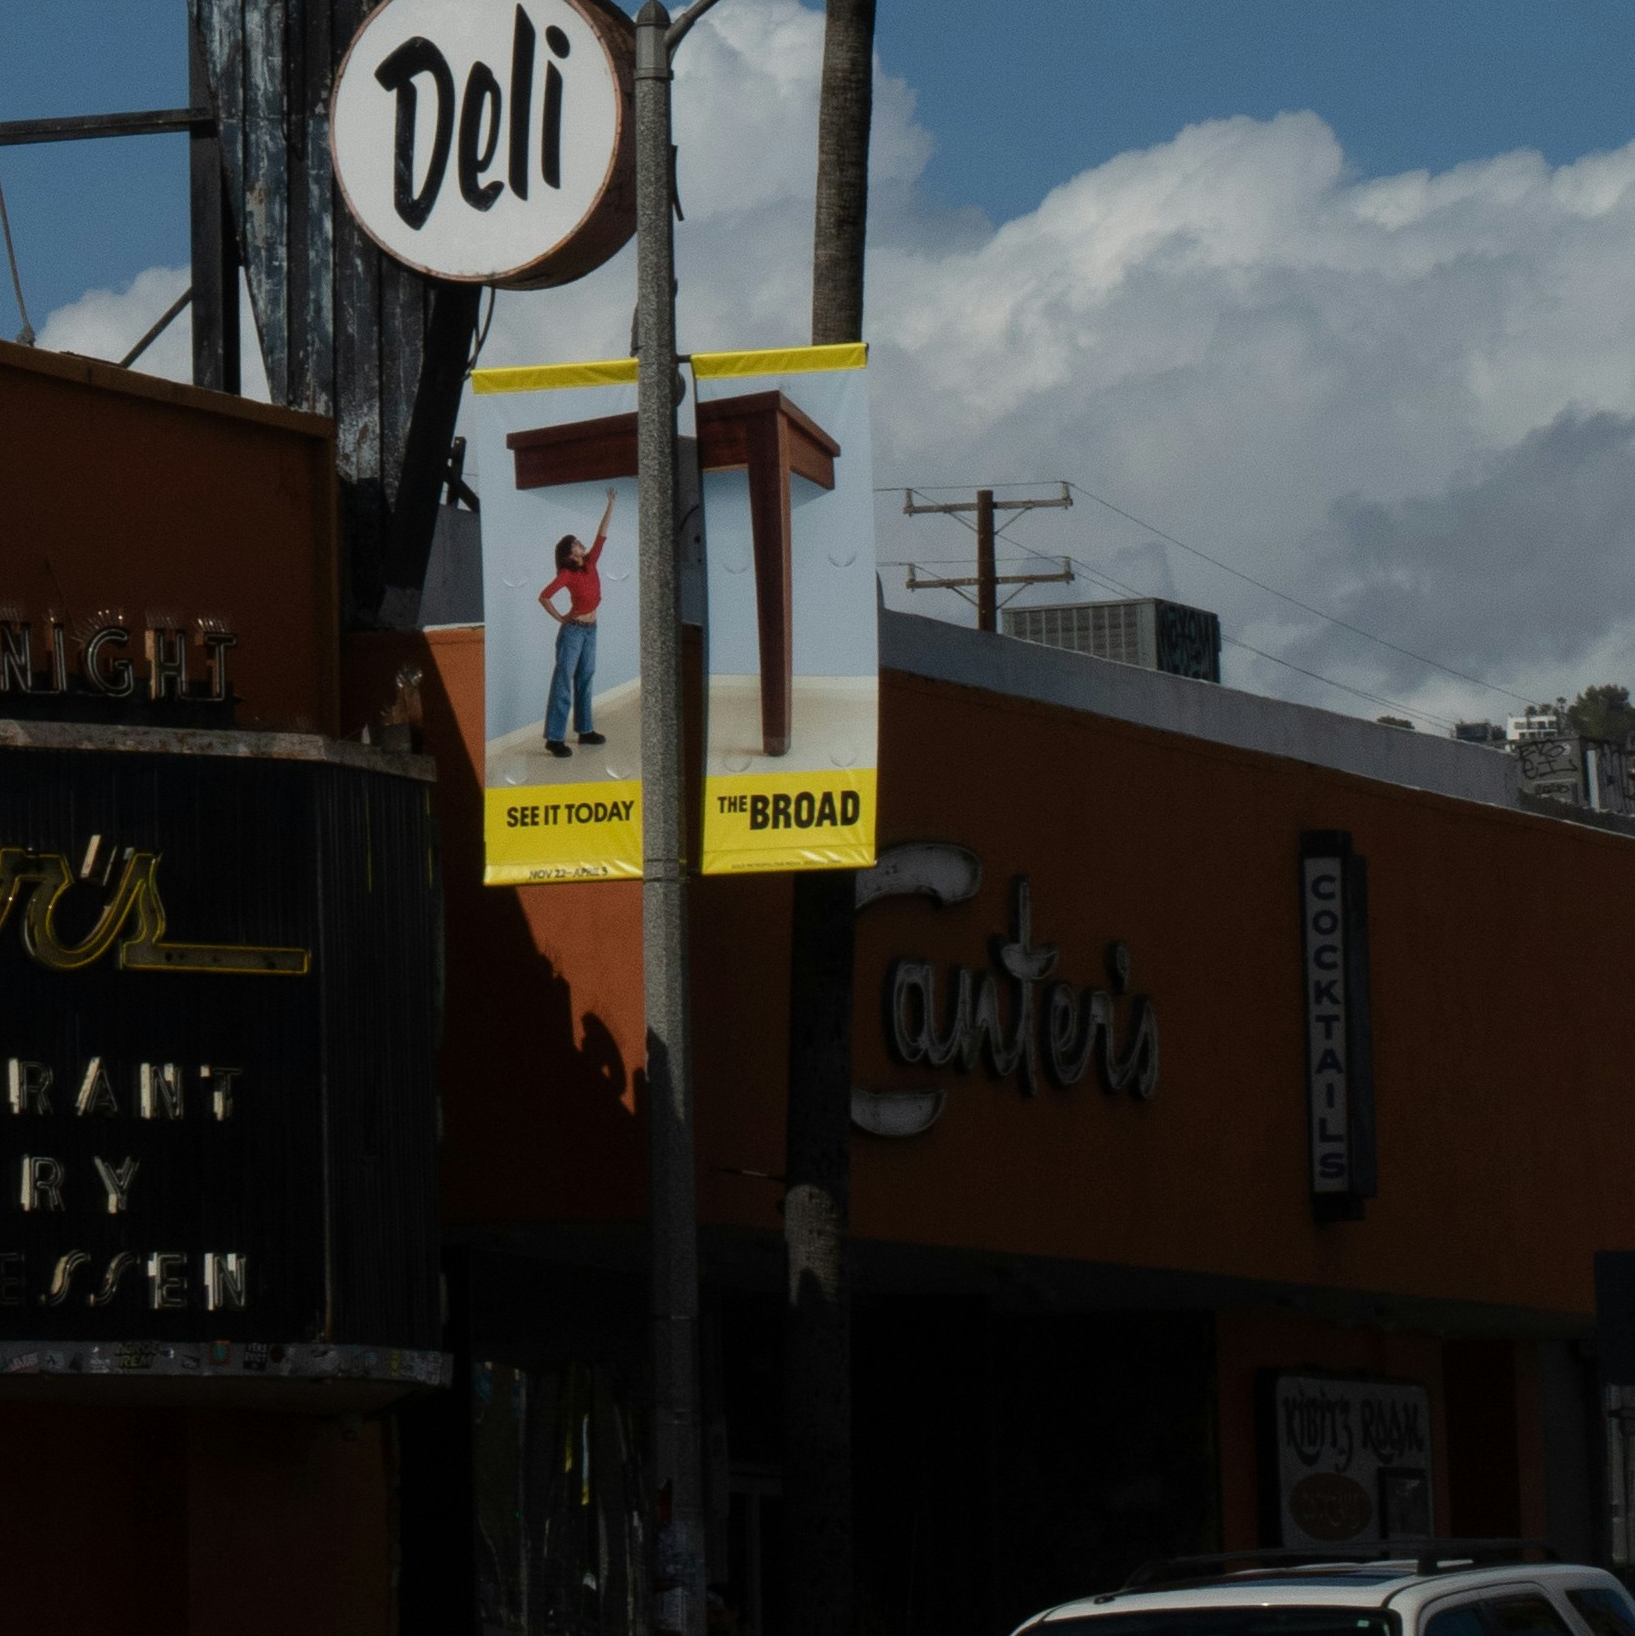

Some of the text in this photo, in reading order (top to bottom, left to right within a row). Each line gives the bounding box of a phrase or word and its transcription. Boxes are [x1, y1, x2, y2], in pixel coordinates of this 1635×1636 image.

[374, 3, 571, 231] Deli
[507, 800, 635, 828] SEE IT TODAY
[718, 790, 860, 830] THE BROAD
[1311, 874, 1346, 1179] COCKTAILS
